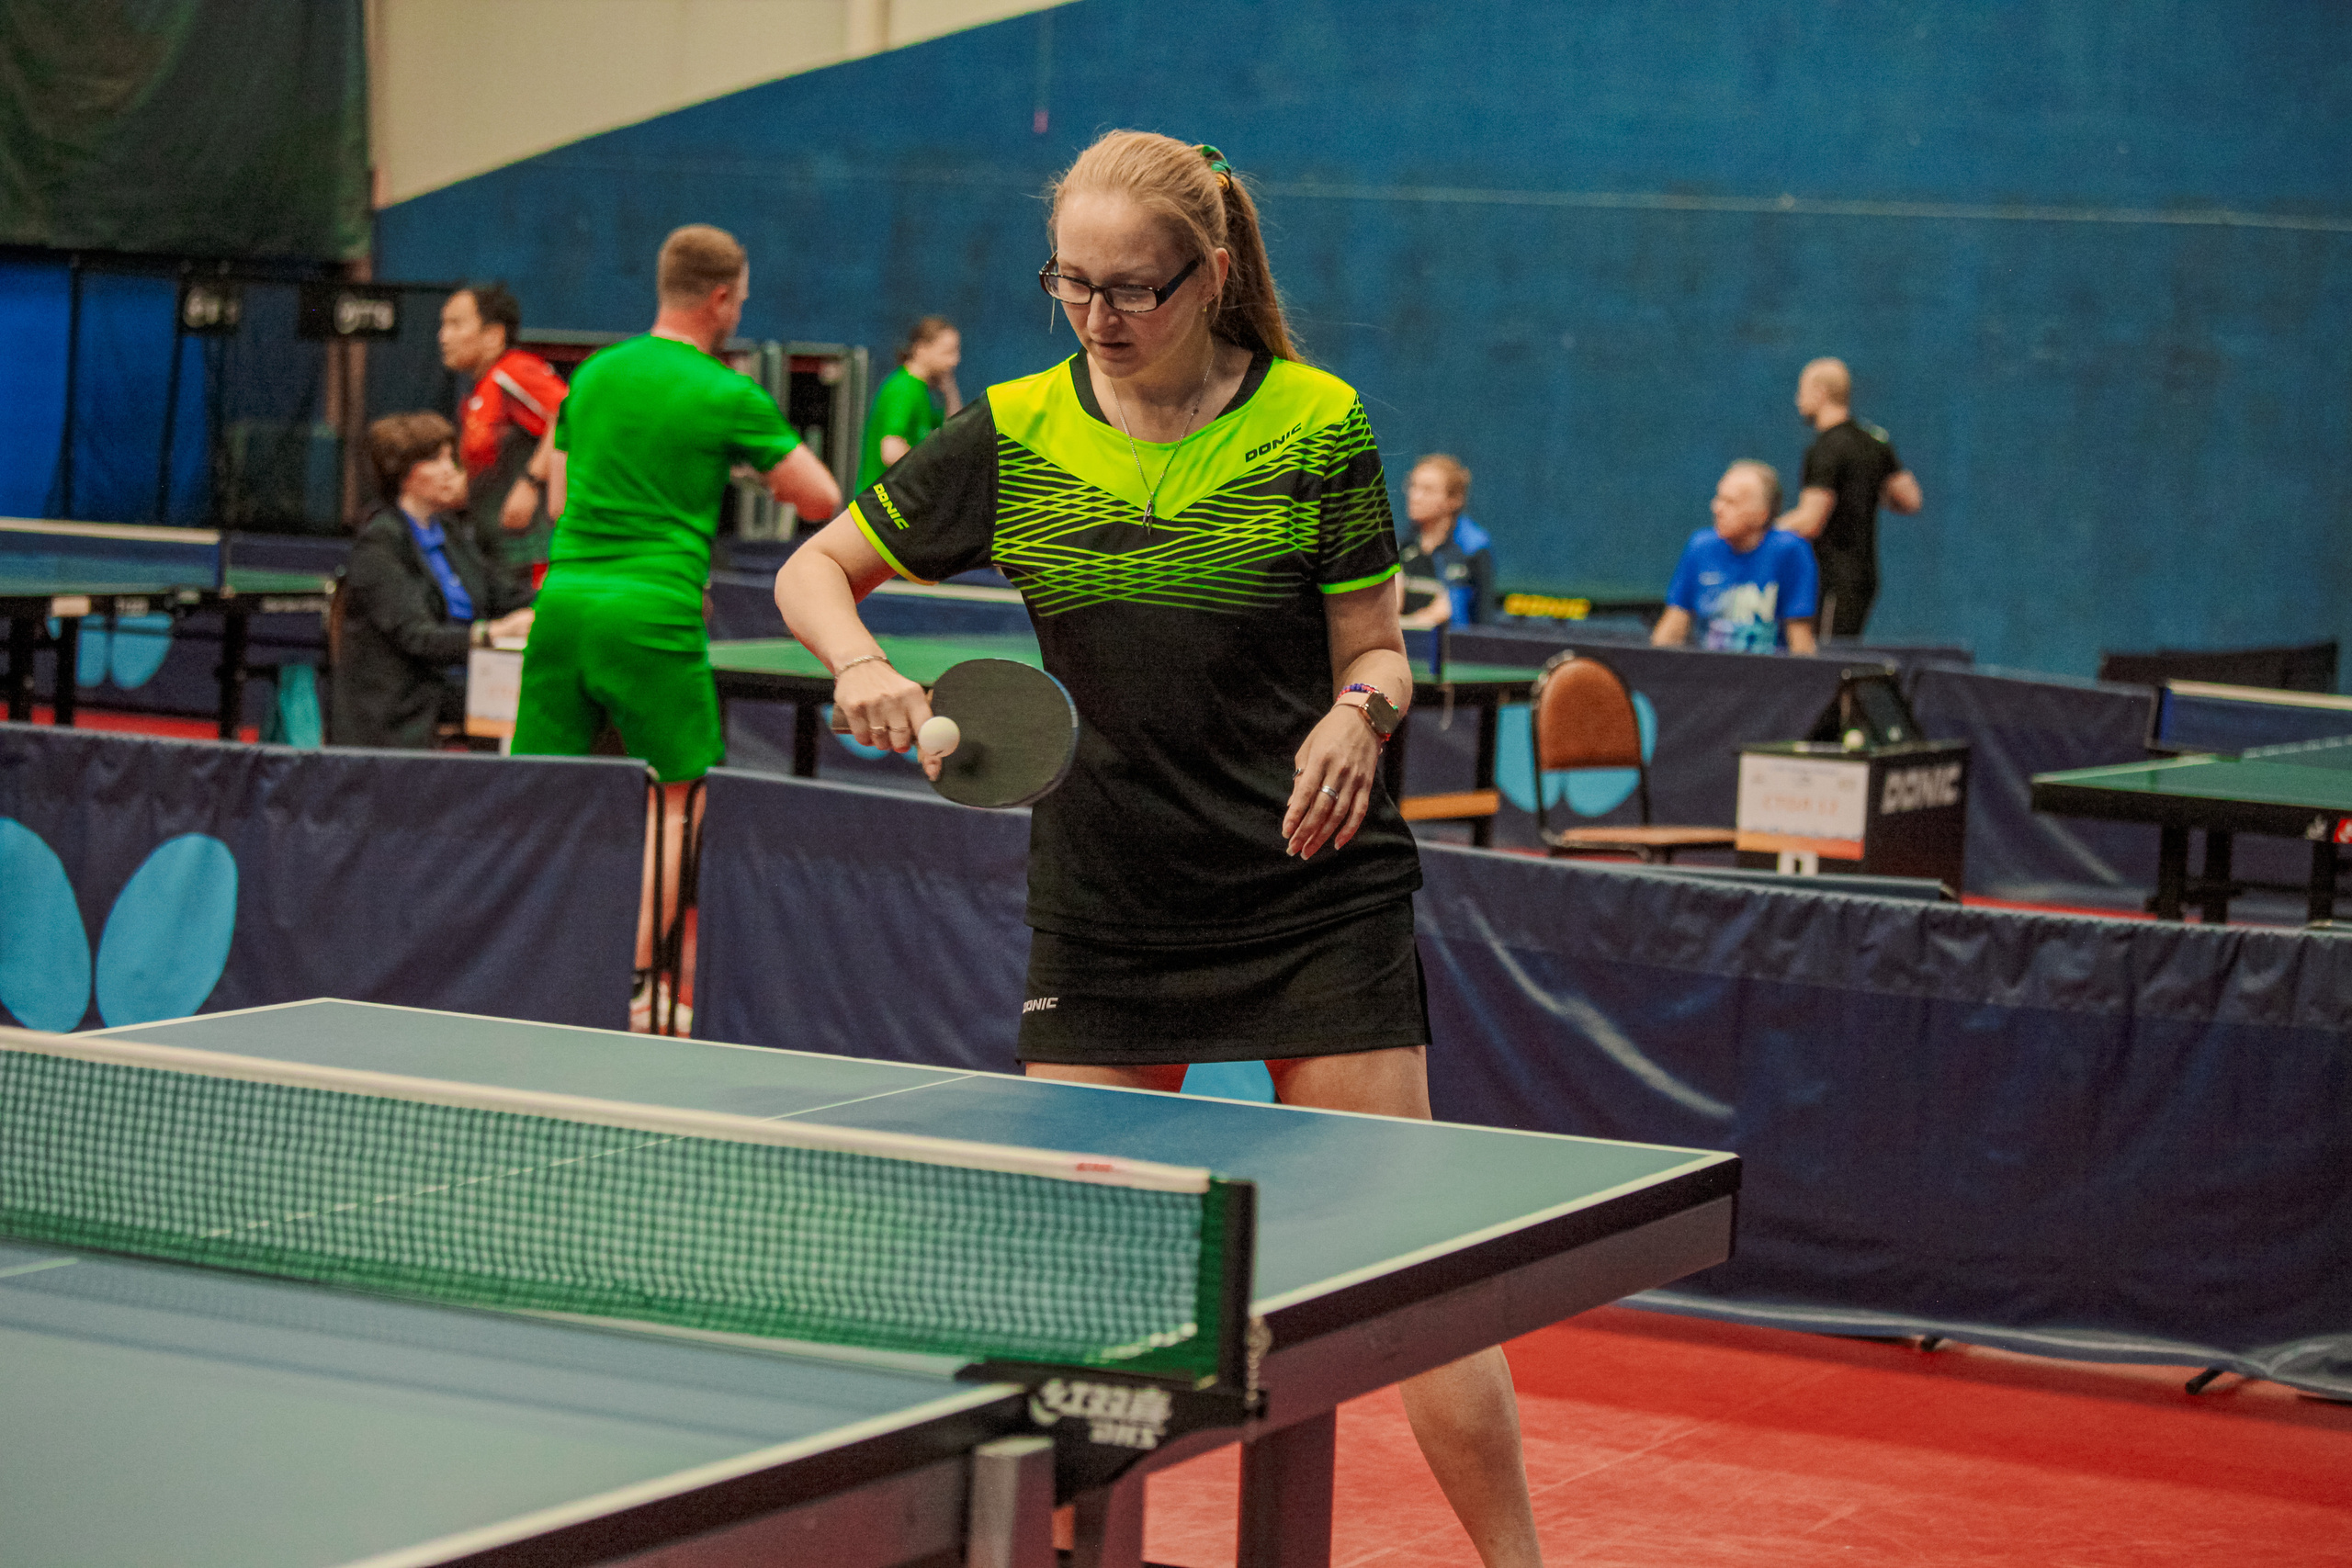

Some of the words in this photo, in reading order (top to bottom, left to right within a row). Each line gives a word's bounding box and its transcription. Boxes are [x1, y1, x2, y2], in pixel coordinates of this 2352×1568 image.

[1245, 422, 1302, 463] DONIC
[872, 482, 910, 531] DONIC
[1881, 763, 1962, 815] DONIC
